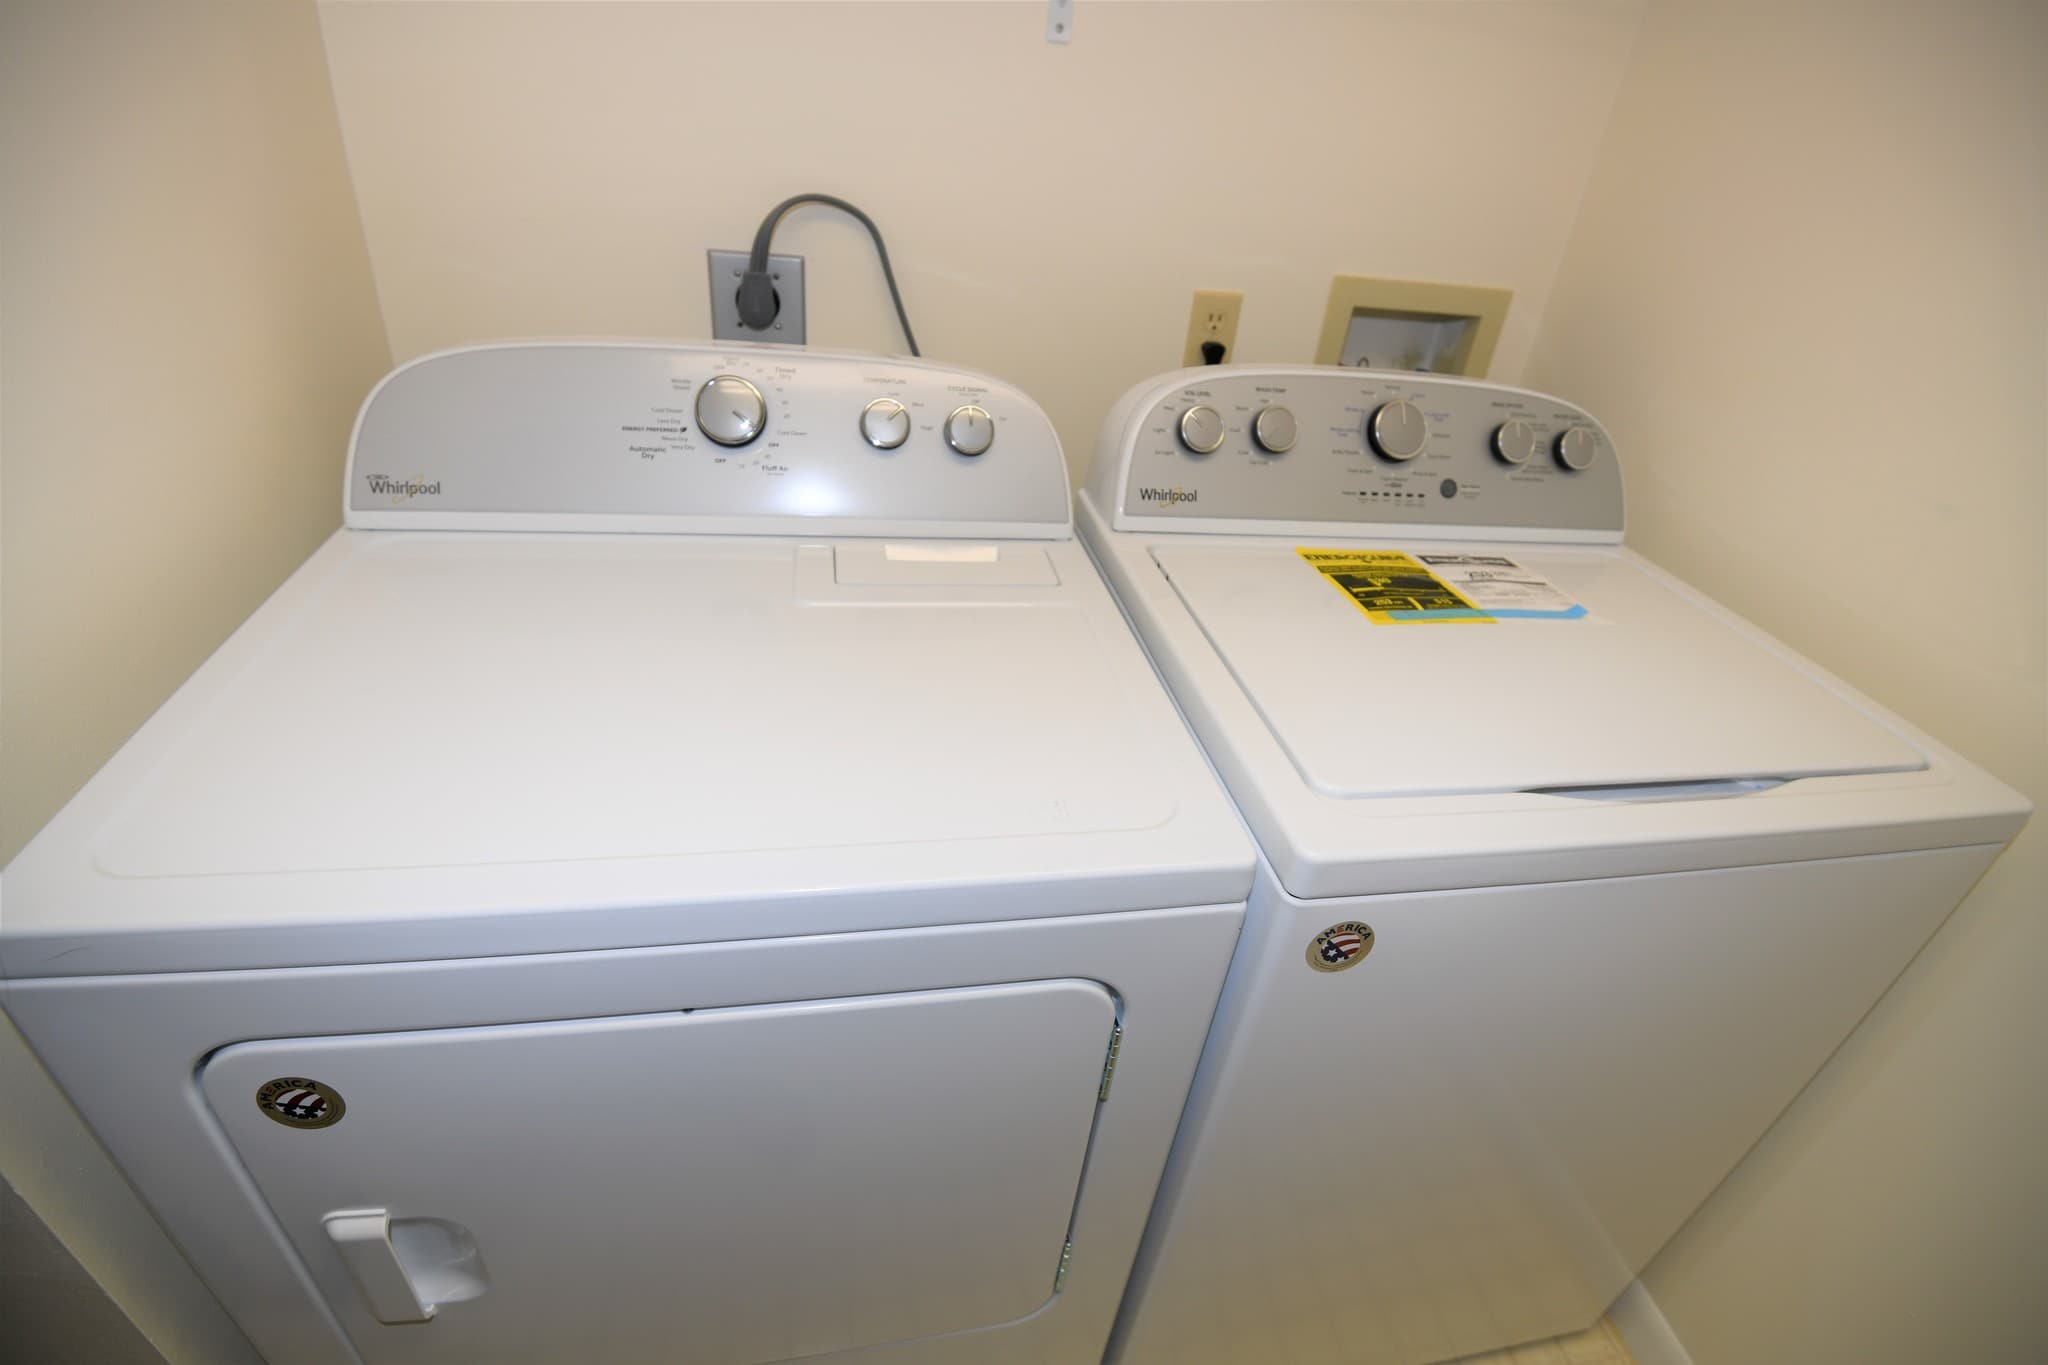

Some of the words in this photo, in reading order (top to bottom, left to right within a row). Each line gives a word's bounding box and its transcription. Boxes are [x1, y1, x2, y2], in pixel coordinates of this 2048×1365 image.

[629, 445, 667, 453] Automatic
[641, 452, 655, 460] Dry
[369, 480, 441, 498] Whirlpool
[1139, 487, 1198, 504] Whirlpool
[1317, 923, 1372, 945] AMERICA
[260, 1080, 317, 1110] AMERICA
